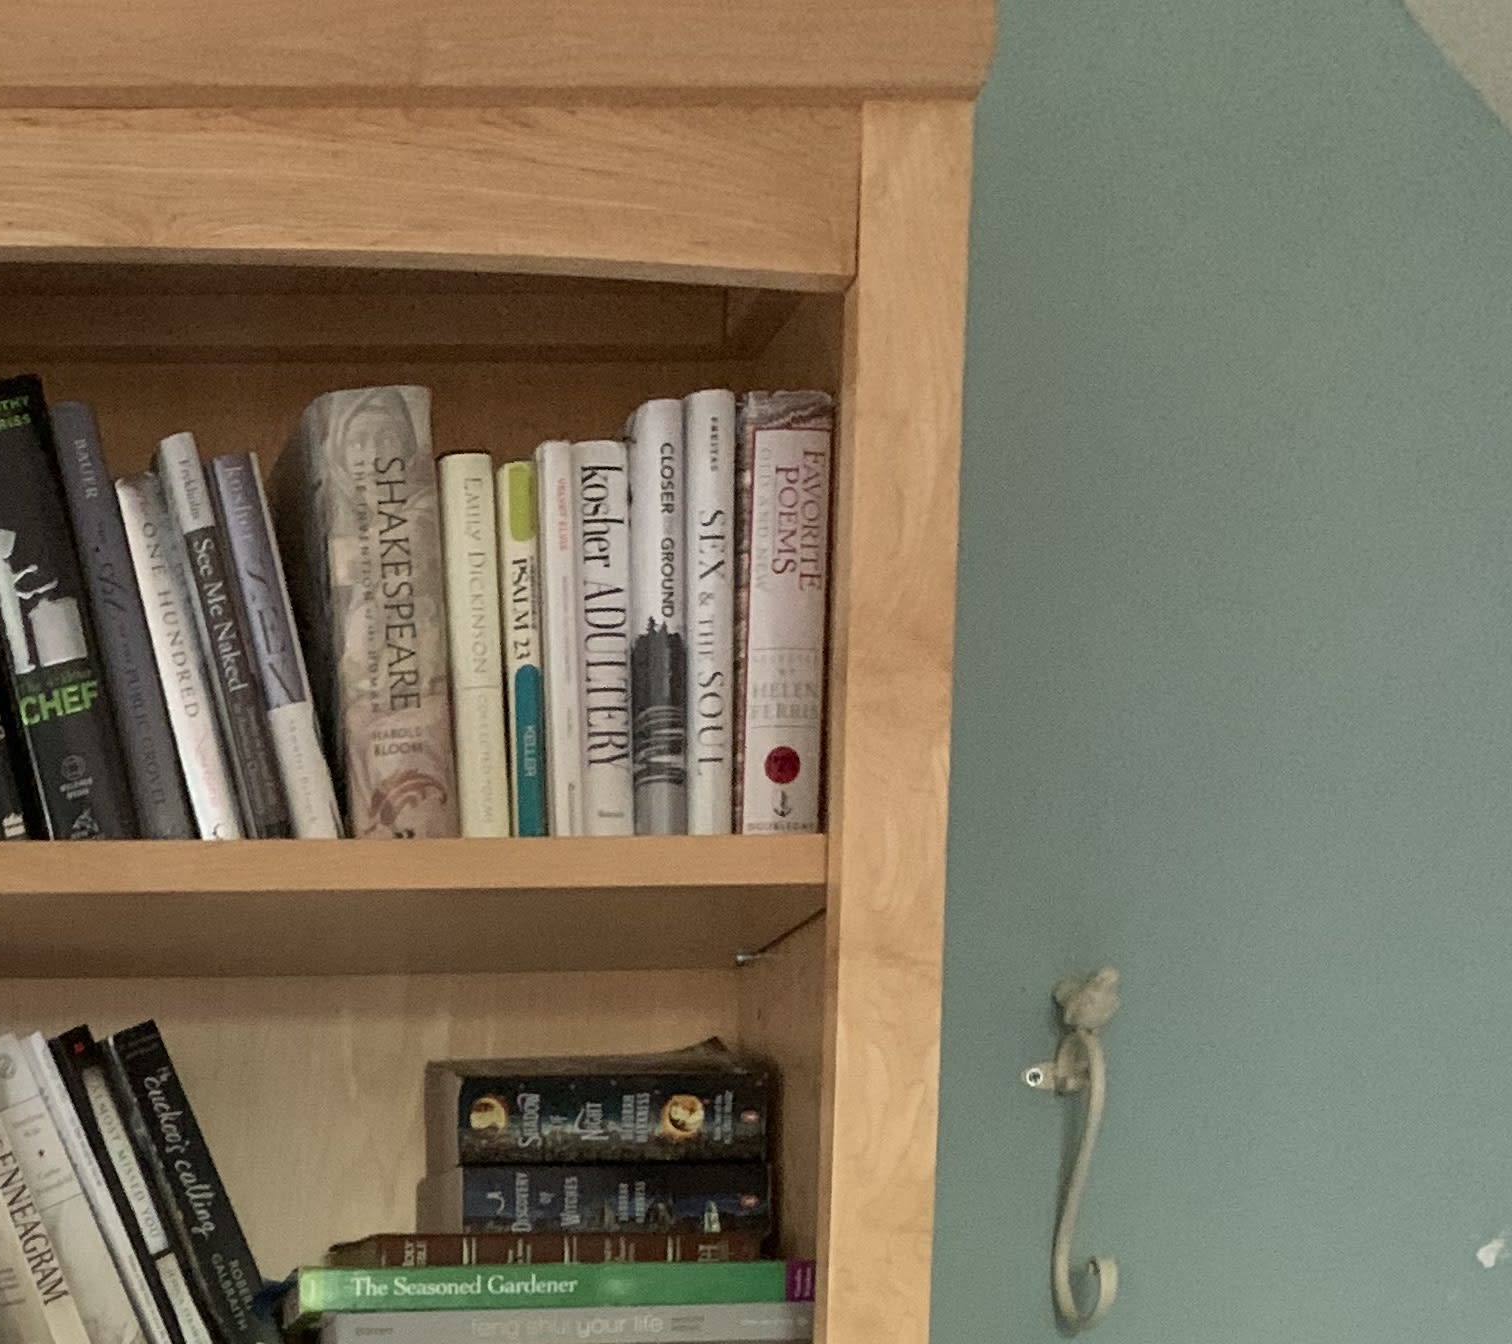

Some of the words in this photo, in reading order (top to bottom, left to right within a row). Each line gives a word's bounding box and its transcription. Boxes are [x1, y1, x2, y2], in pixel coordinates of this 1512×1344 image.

[580, 466, 621, 568] kosher
[659, 442, 675, 514] CLOSER
[771, 466, 800, 574] POEMS
[191, 538, 214, 576] See
[203, 581, 224, 617] Me
[214, 623, 247, 692] Naked
[373, 457, 420, 710] SHAKESPEARE
[512, 559, 530, 630] PSALM
[659, 538, 675, 618] GROUND
[142, 522, 166, 581] ONE
[156, 590, 201, 719] HUNDRED
[513, 640, 530, 659] 23
[20, 682, 98, 726] CHEF
[583, 580, 628, 769] ADULTERY
[523, 725, 537, 776] KELLER
[351, 1275, 389, 1297] The
[393, 1276, 481, 1296] Seasoned
[486, 1275, 578, 1294] Gardener
